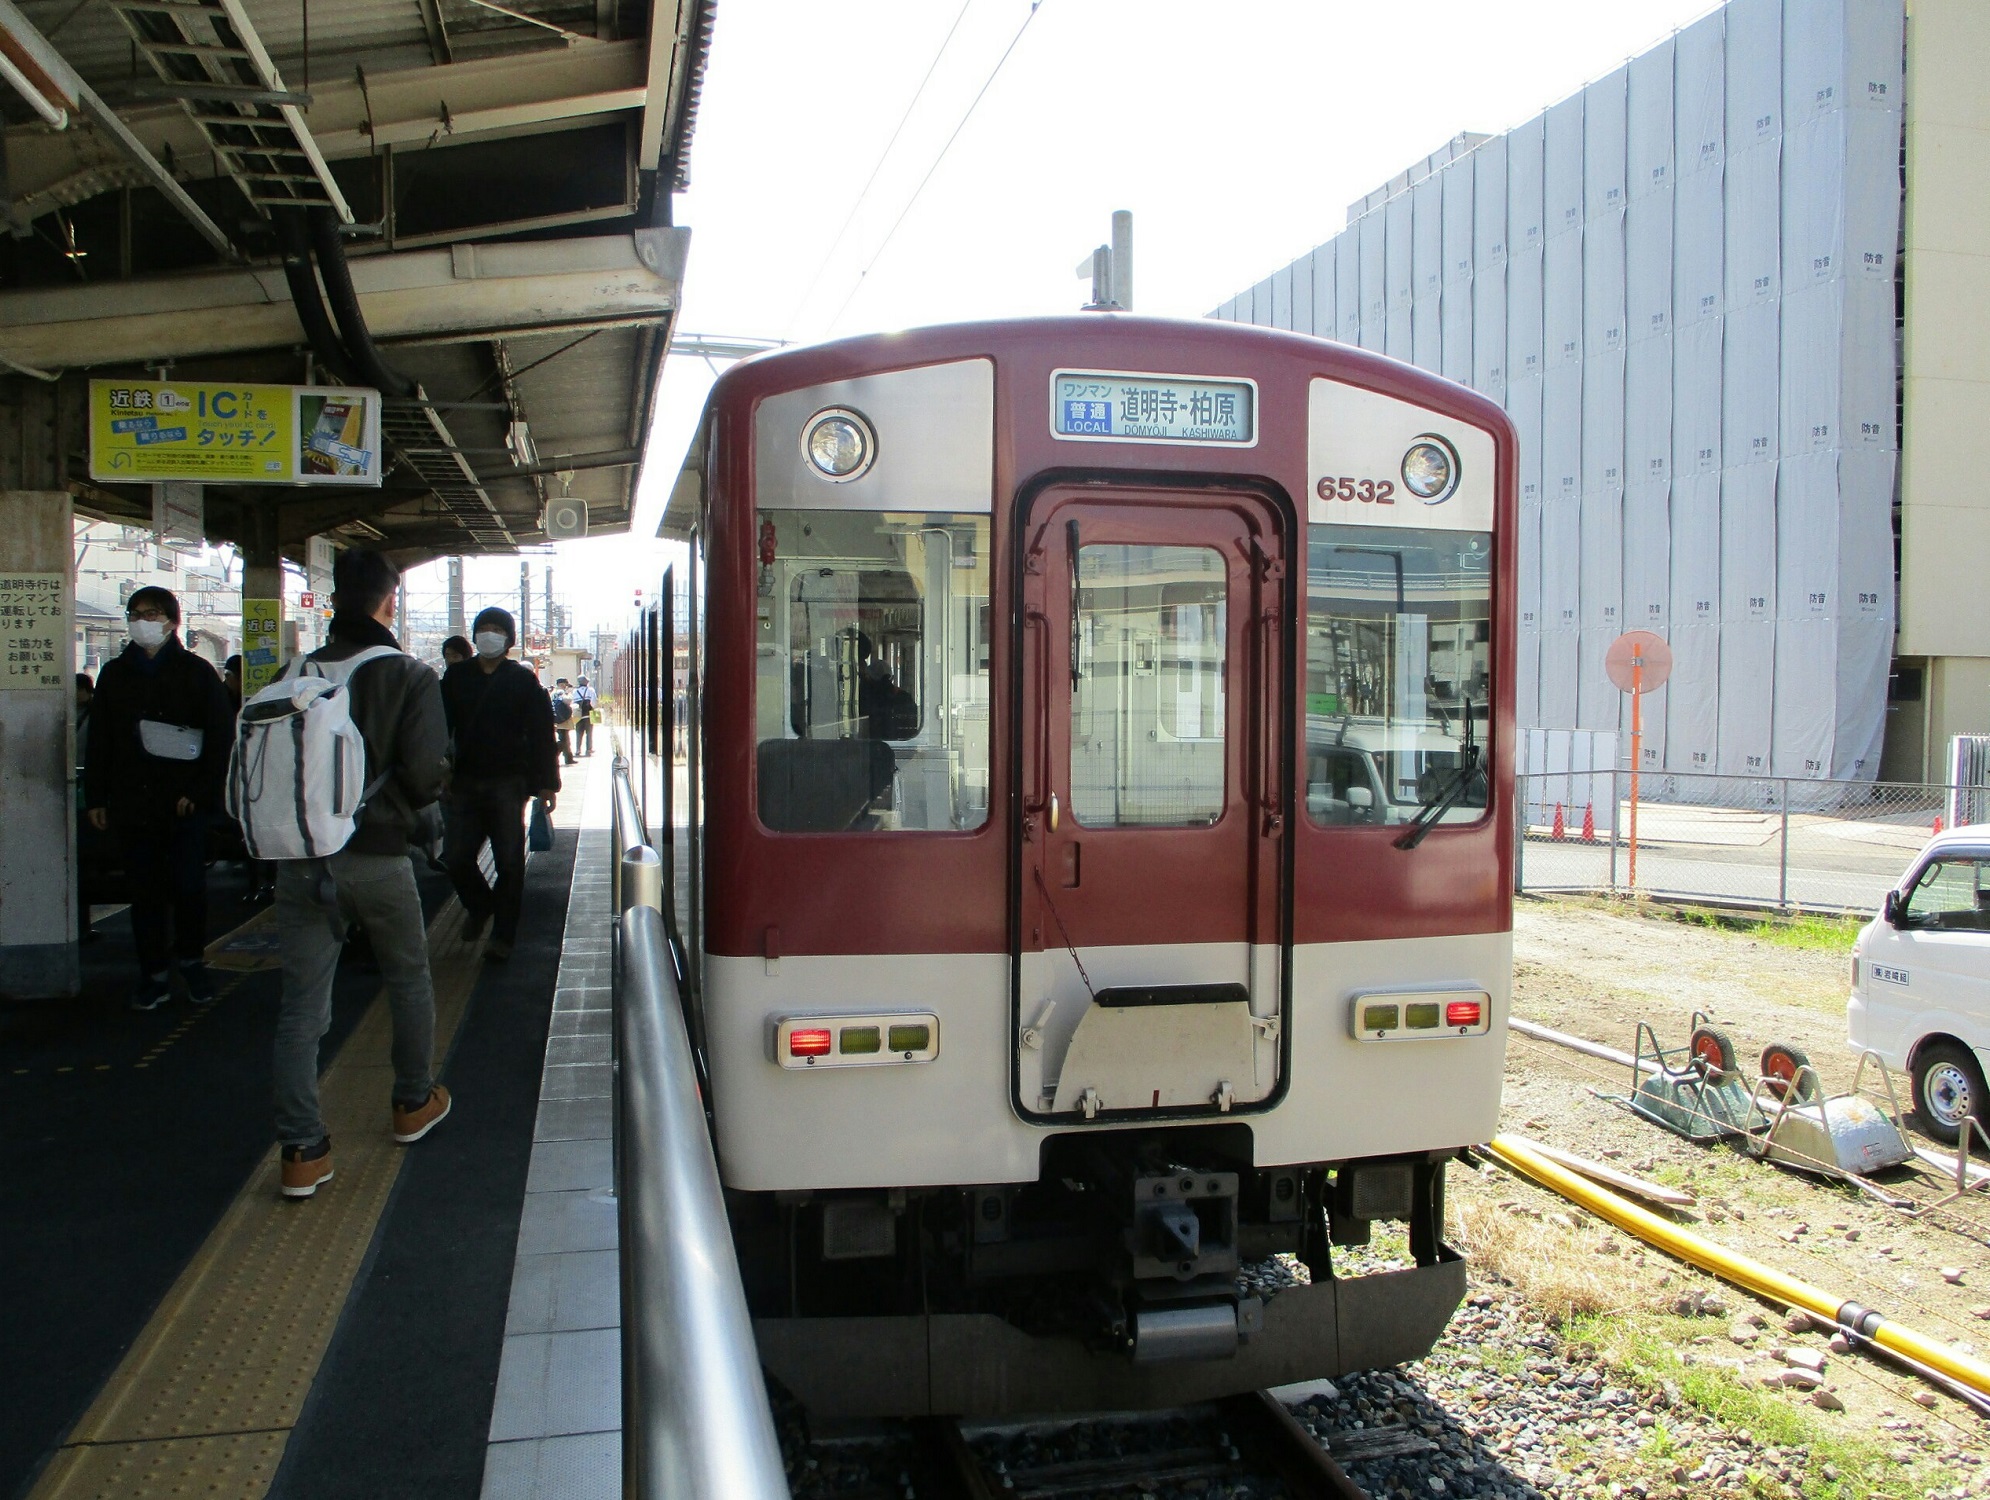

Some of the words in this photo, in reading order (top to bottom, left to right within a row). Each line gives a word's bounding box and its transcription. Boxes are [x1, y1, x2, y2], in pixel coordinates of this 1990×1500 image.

[1868, 82, 1887, 94] 防音
[1814, 256, 1830, 270] 防音
[1863, 253, 1884, 265] 防音
[1754, 277, 1769, 289] 防音
[1064, 383, 1112, 398] ワンマン
[110, 389, 153, 409] 近鉄
[198, 391, 238, 419] IC
[1070, 402, 1106, 420] 普通
[1121, 387, 1178, 424] 道明寺
[1190, 391, 1236, 427] 柏原
[1067, 420, 1110, 433] LOCAL
[1812, 425, 1828, 437] 防音
[1861, 423, 1880, 435] 防音
[1182, 427, 1238, 440] KASHIWARA
[1753, 437, 1768, 448] 防音
[1317, 476, 1395, 504] 6532
[0, 580, 60, 590] 道明寺行は
[1750, 597, 1765, 608] 防音
[1809, 593, 1826, 604] 防音
[1858, 593, 1878, 604] 防音
[0, 606, 61, 616] 運転してお
[1696, 601, 1711, 611] 防音
[2, 619, 36, 629] ります
[246, 619, 276, 632] 近鉄
[8, 639, 53, 649] ご協力を
[8, 652, 55, 661] お願い致
[9, 665, 42, 675] します
